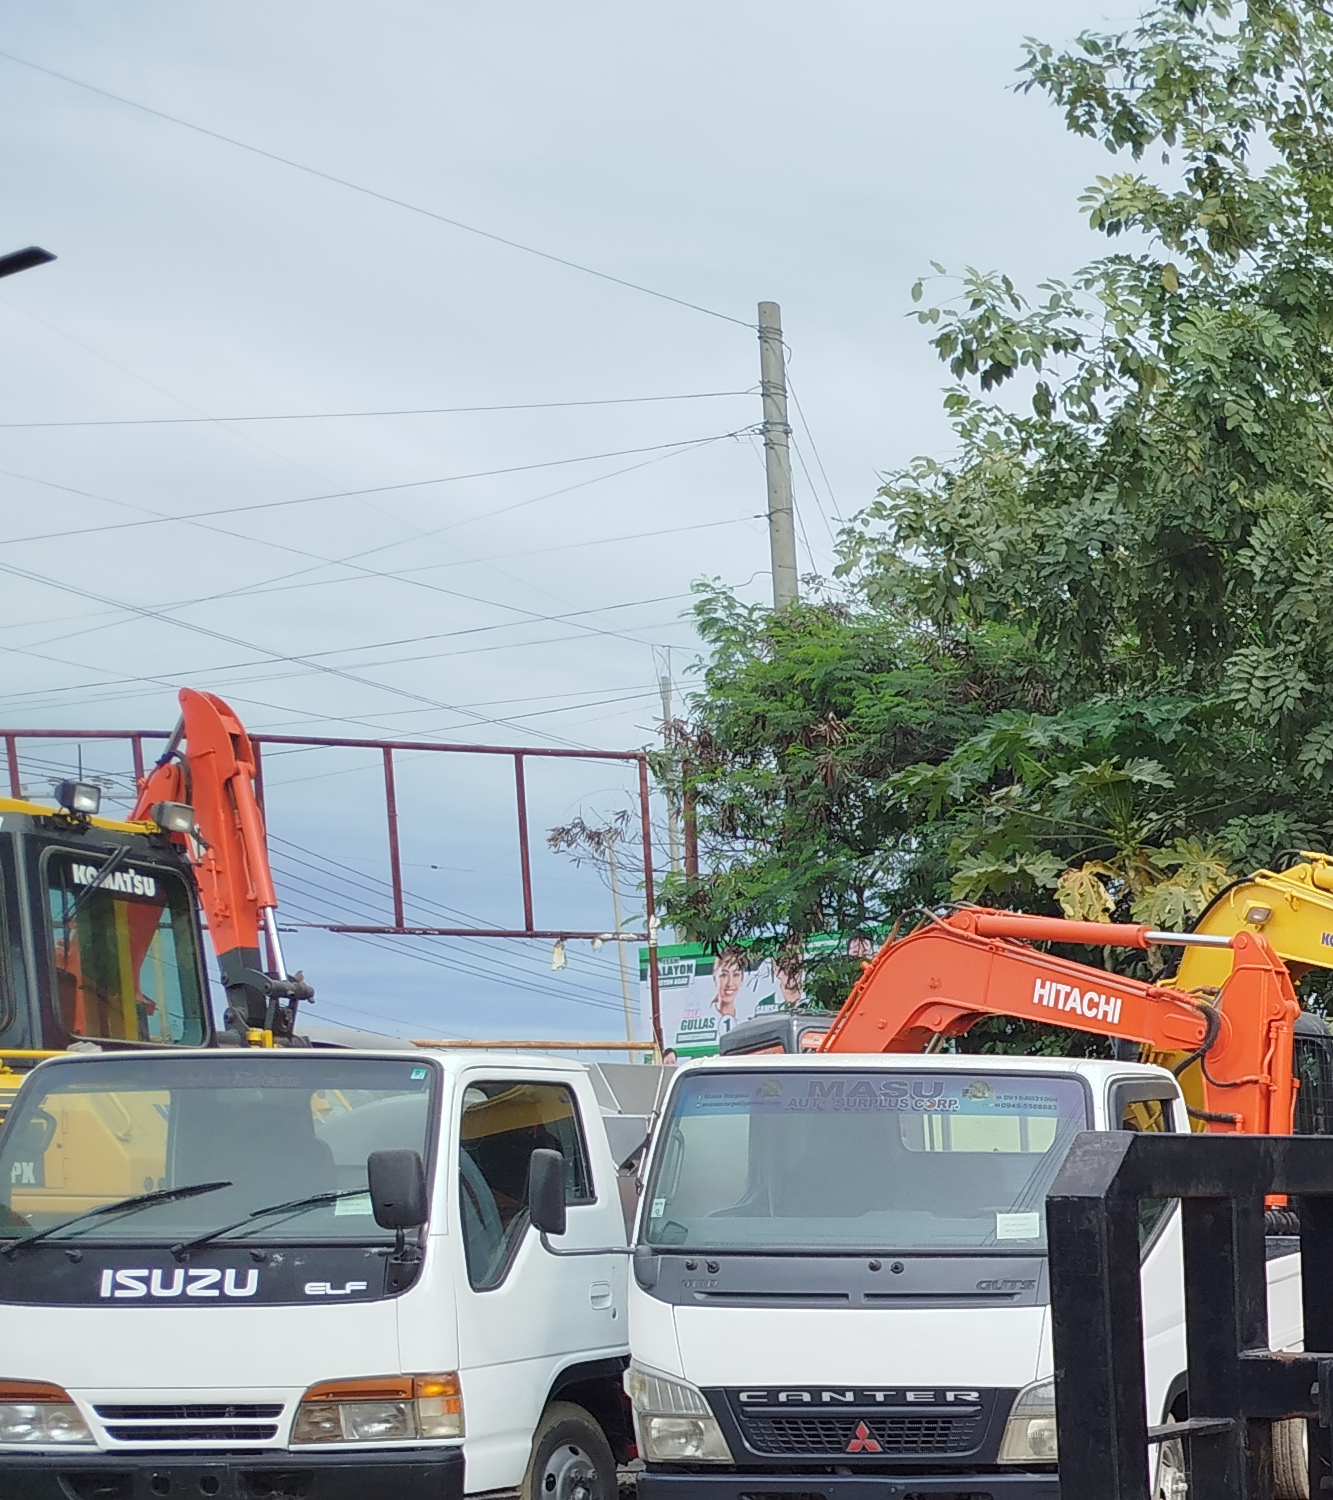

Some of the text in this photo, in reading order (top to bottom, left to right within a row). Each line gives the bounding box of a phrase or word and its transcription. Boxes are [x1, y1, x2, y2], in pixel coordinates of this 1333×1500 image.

[1032, 978, 1122, 1024] HITACHI
[681, 1017, 716, 1031] GULLAS
[723, 1018, 731, 1032] 1
[808, 1080, 945, 1099] MASU
[834, 1098, 909, 1109] SURPLUS
[100, 1269, 259, 1298] ISUZU
[304, 1281, 367, 1295] ELF
[975, 1279, 1036, 1291] GUTS
[739, 1391, 981, 1403] CANTER
